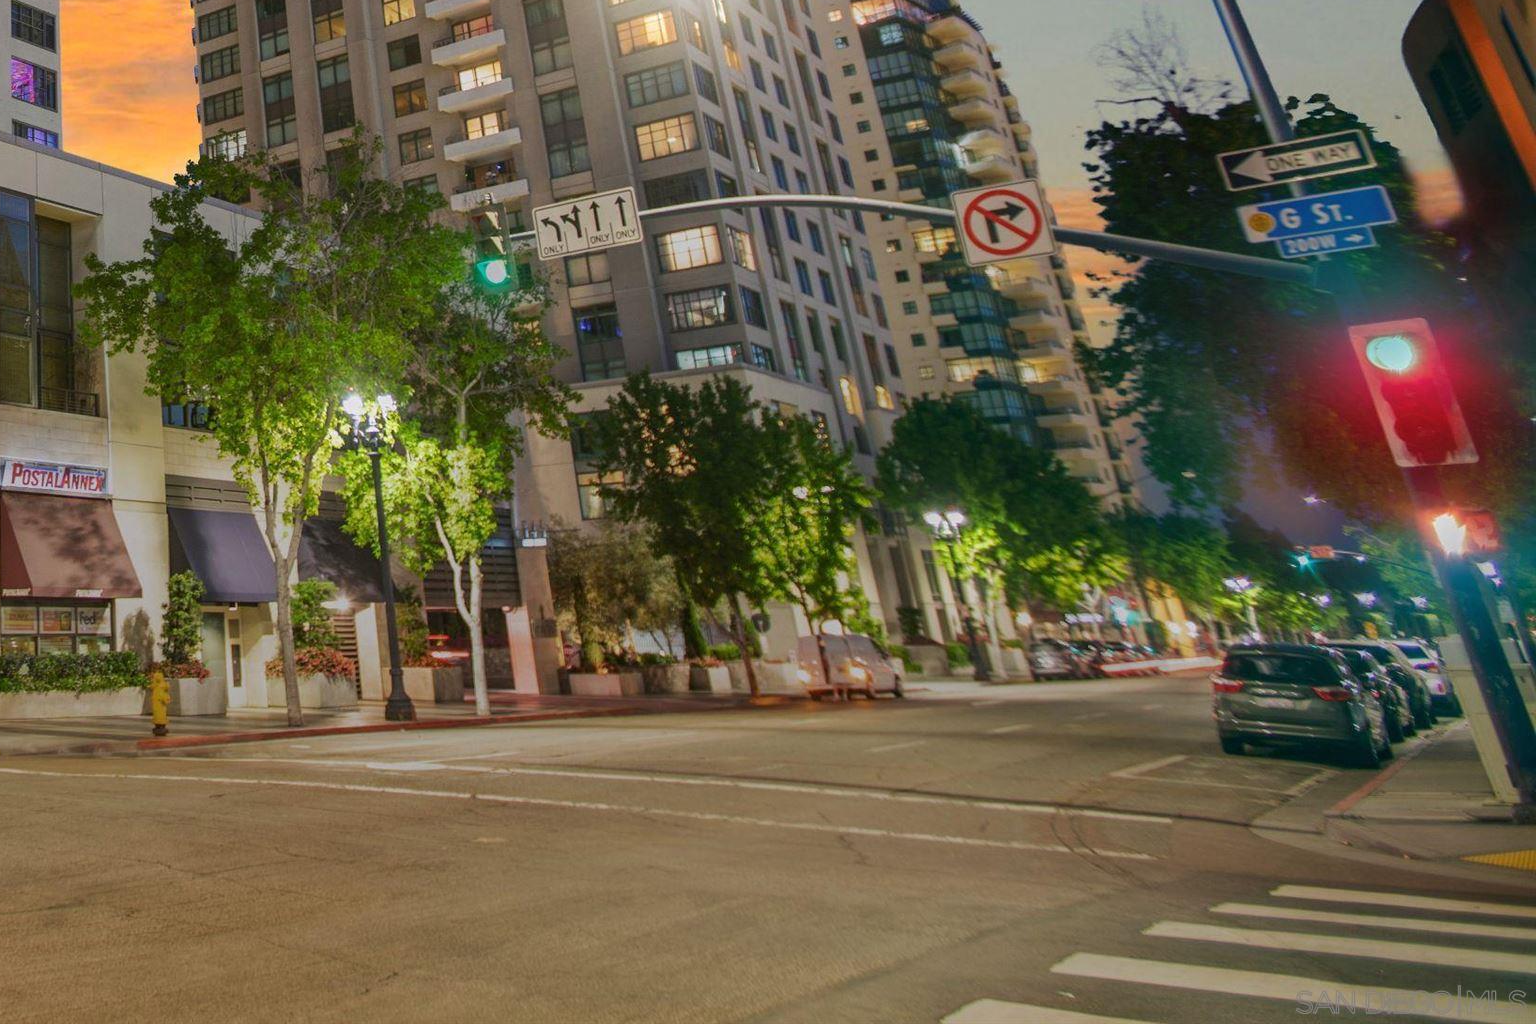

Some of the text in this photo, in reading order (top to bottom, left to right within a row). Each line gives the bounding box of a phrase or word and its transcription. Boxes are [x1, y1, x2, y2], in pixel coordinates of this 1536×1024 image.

[1266, 144, 1352, 172] ONE WAY
[1279, 202, 1355, 229] G ST.
[589, 232, 610, 245] ONLY
[615, 228, 636, 240] ONLY
[543, 243, 564, 256] ONLY
